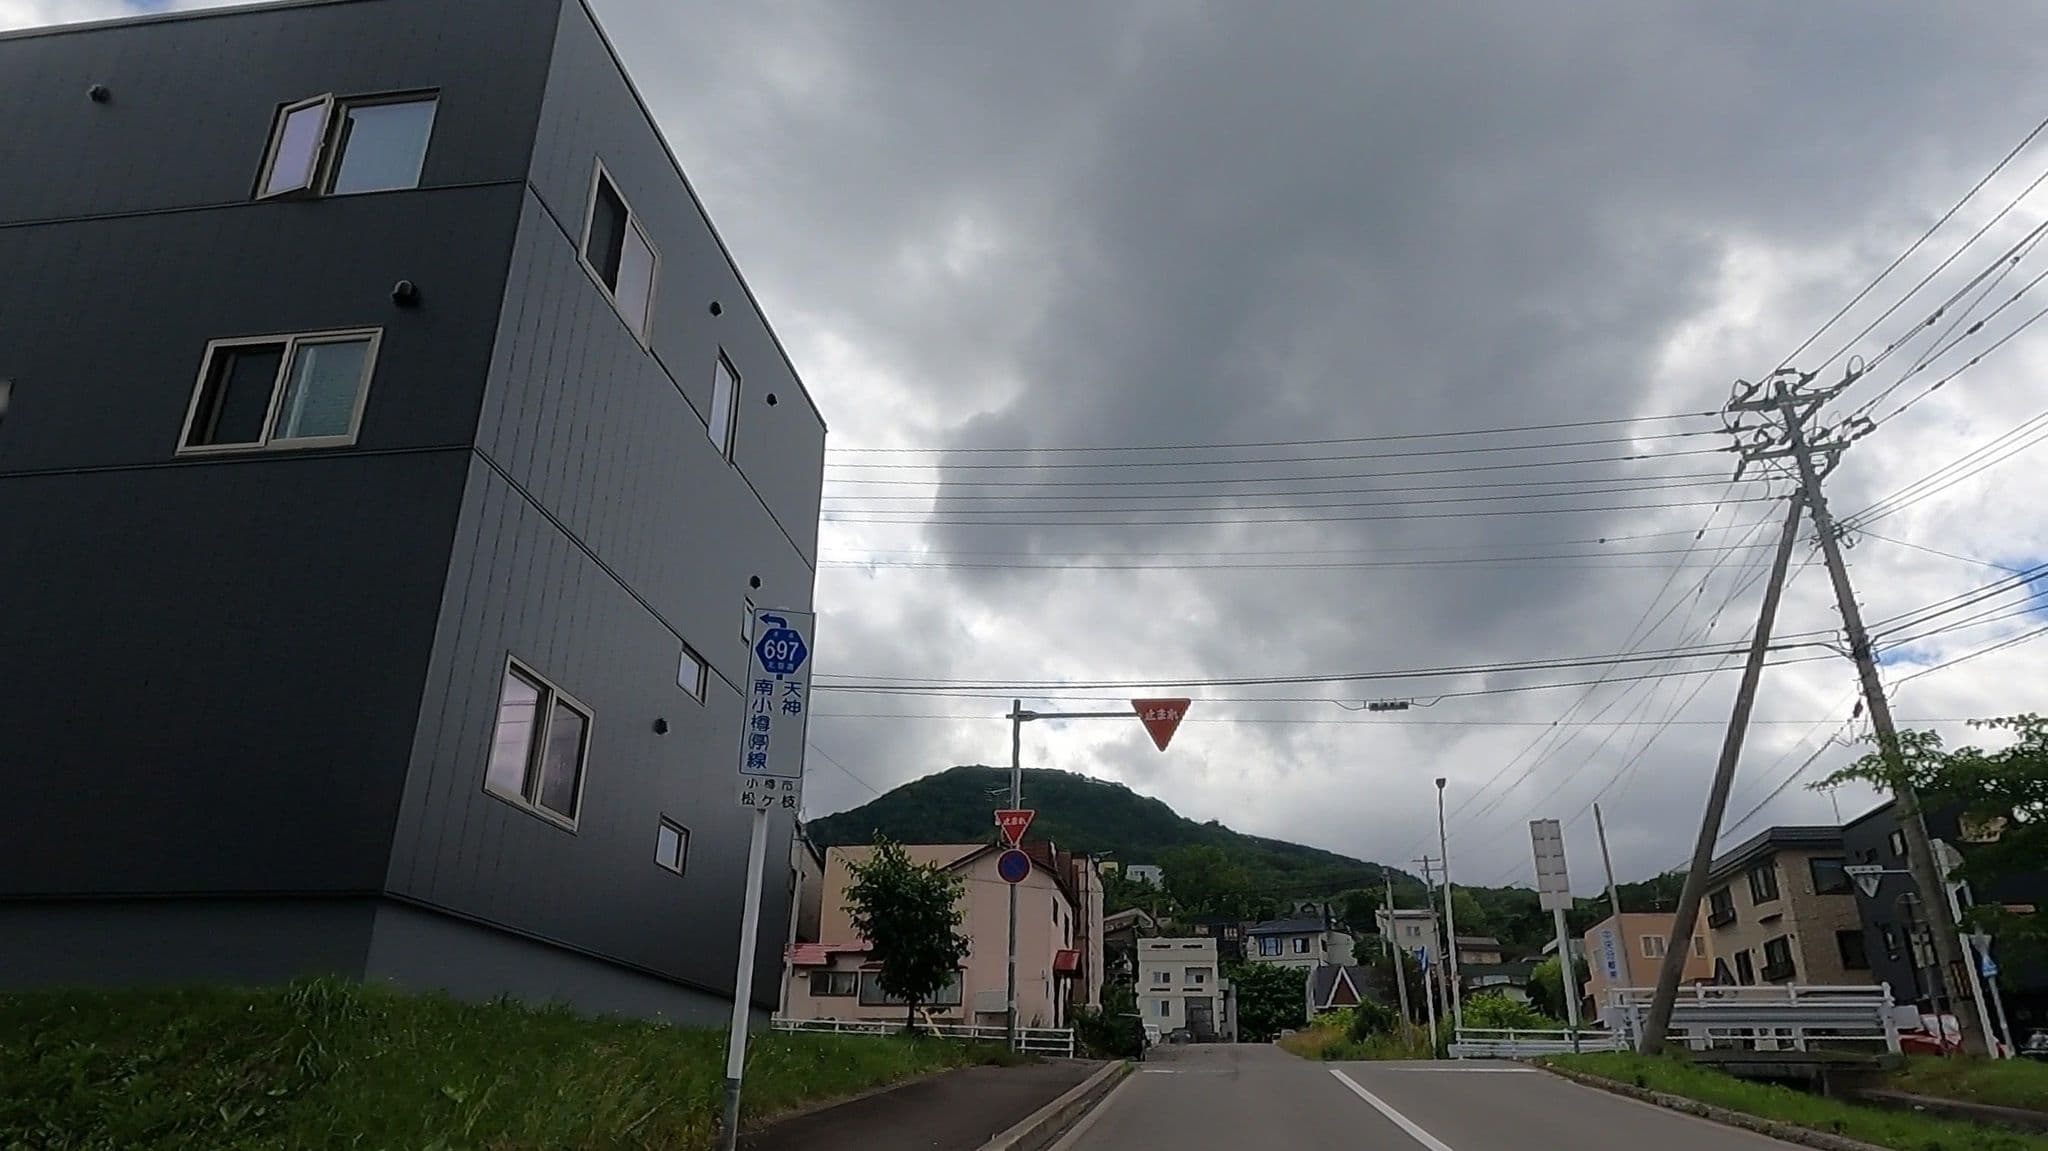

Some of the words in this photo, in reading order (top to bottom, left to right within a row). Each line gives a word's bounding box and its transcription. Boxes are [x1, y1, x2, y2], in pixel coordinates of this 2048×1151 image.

[764, 639, 800, 661] 697
[781, 681, 803, 716] 天神
[746, 778, 793, 791] 小樽市
